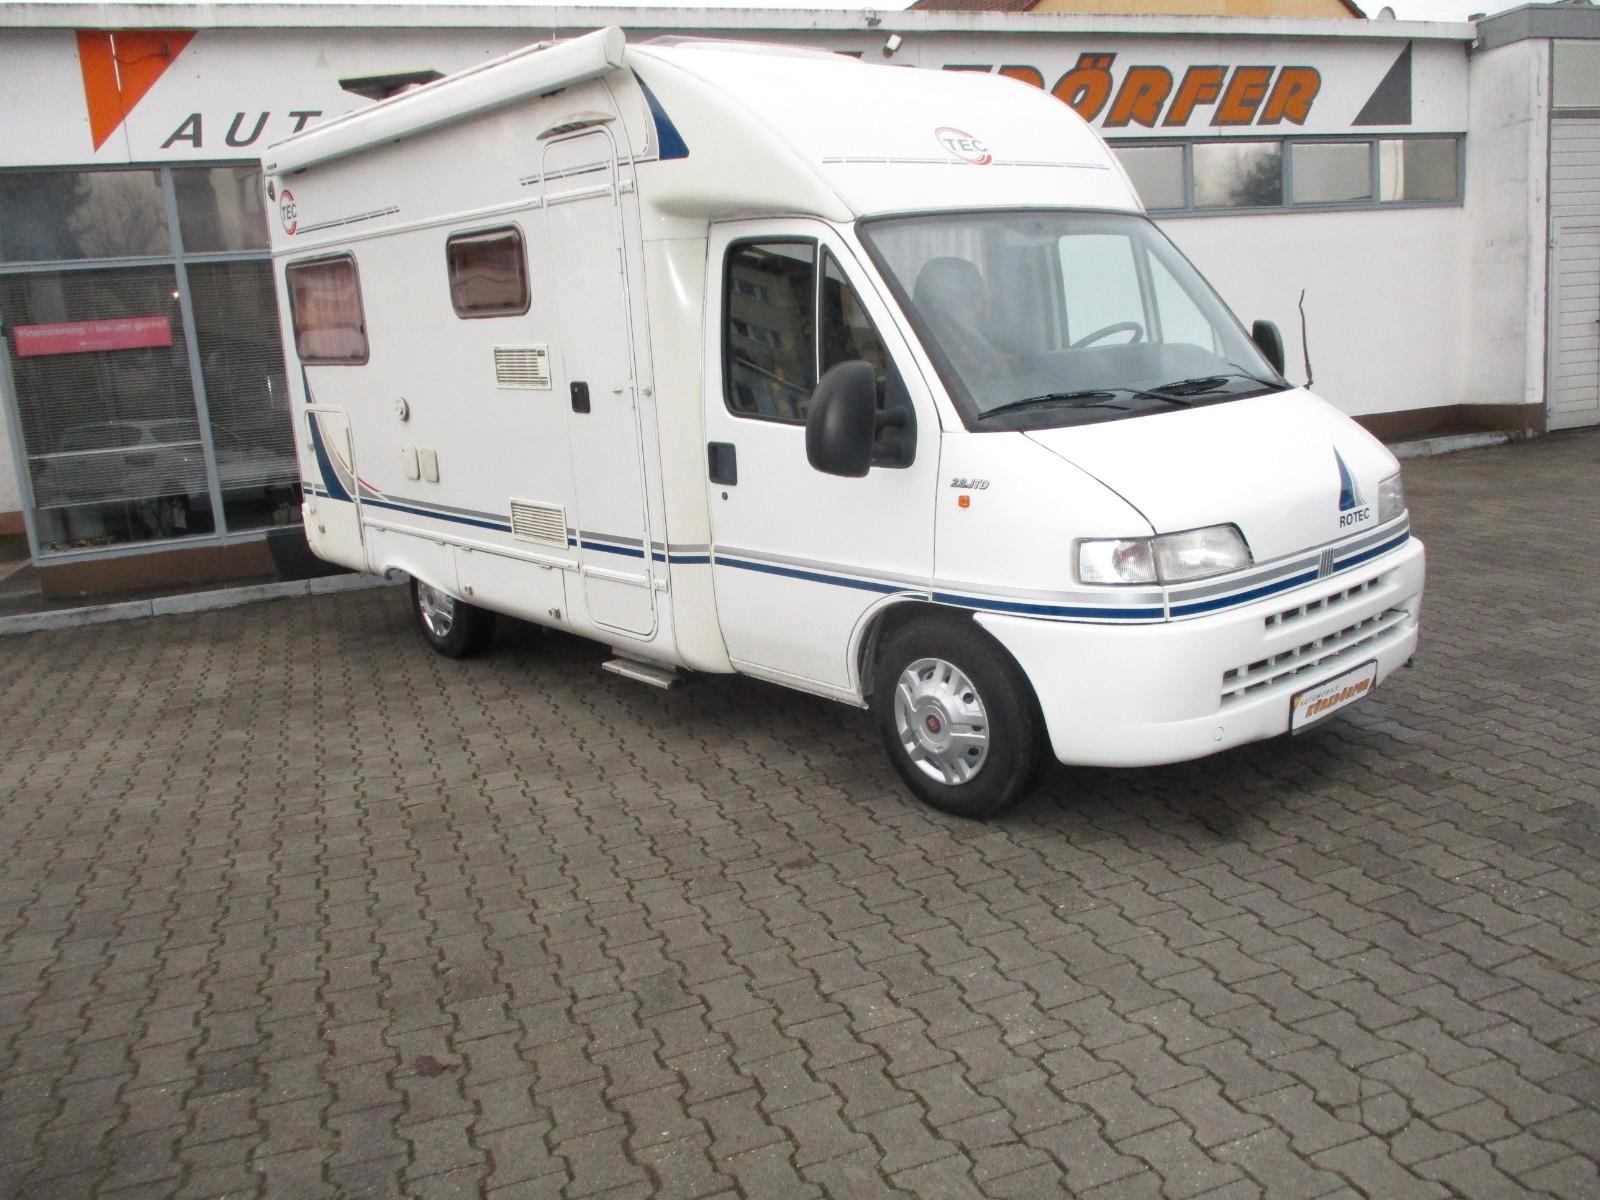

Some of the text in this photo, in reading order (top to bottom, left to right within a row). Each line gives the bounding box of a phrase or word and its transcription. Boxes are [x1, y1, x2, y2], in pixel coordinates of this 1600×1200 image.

[160, 110, 323, 149] AUT
[942, 138, 988, 152] TEC
[282, 203, 297, 220] TEC
[1340, 507, 1370, 528] ROTEC
